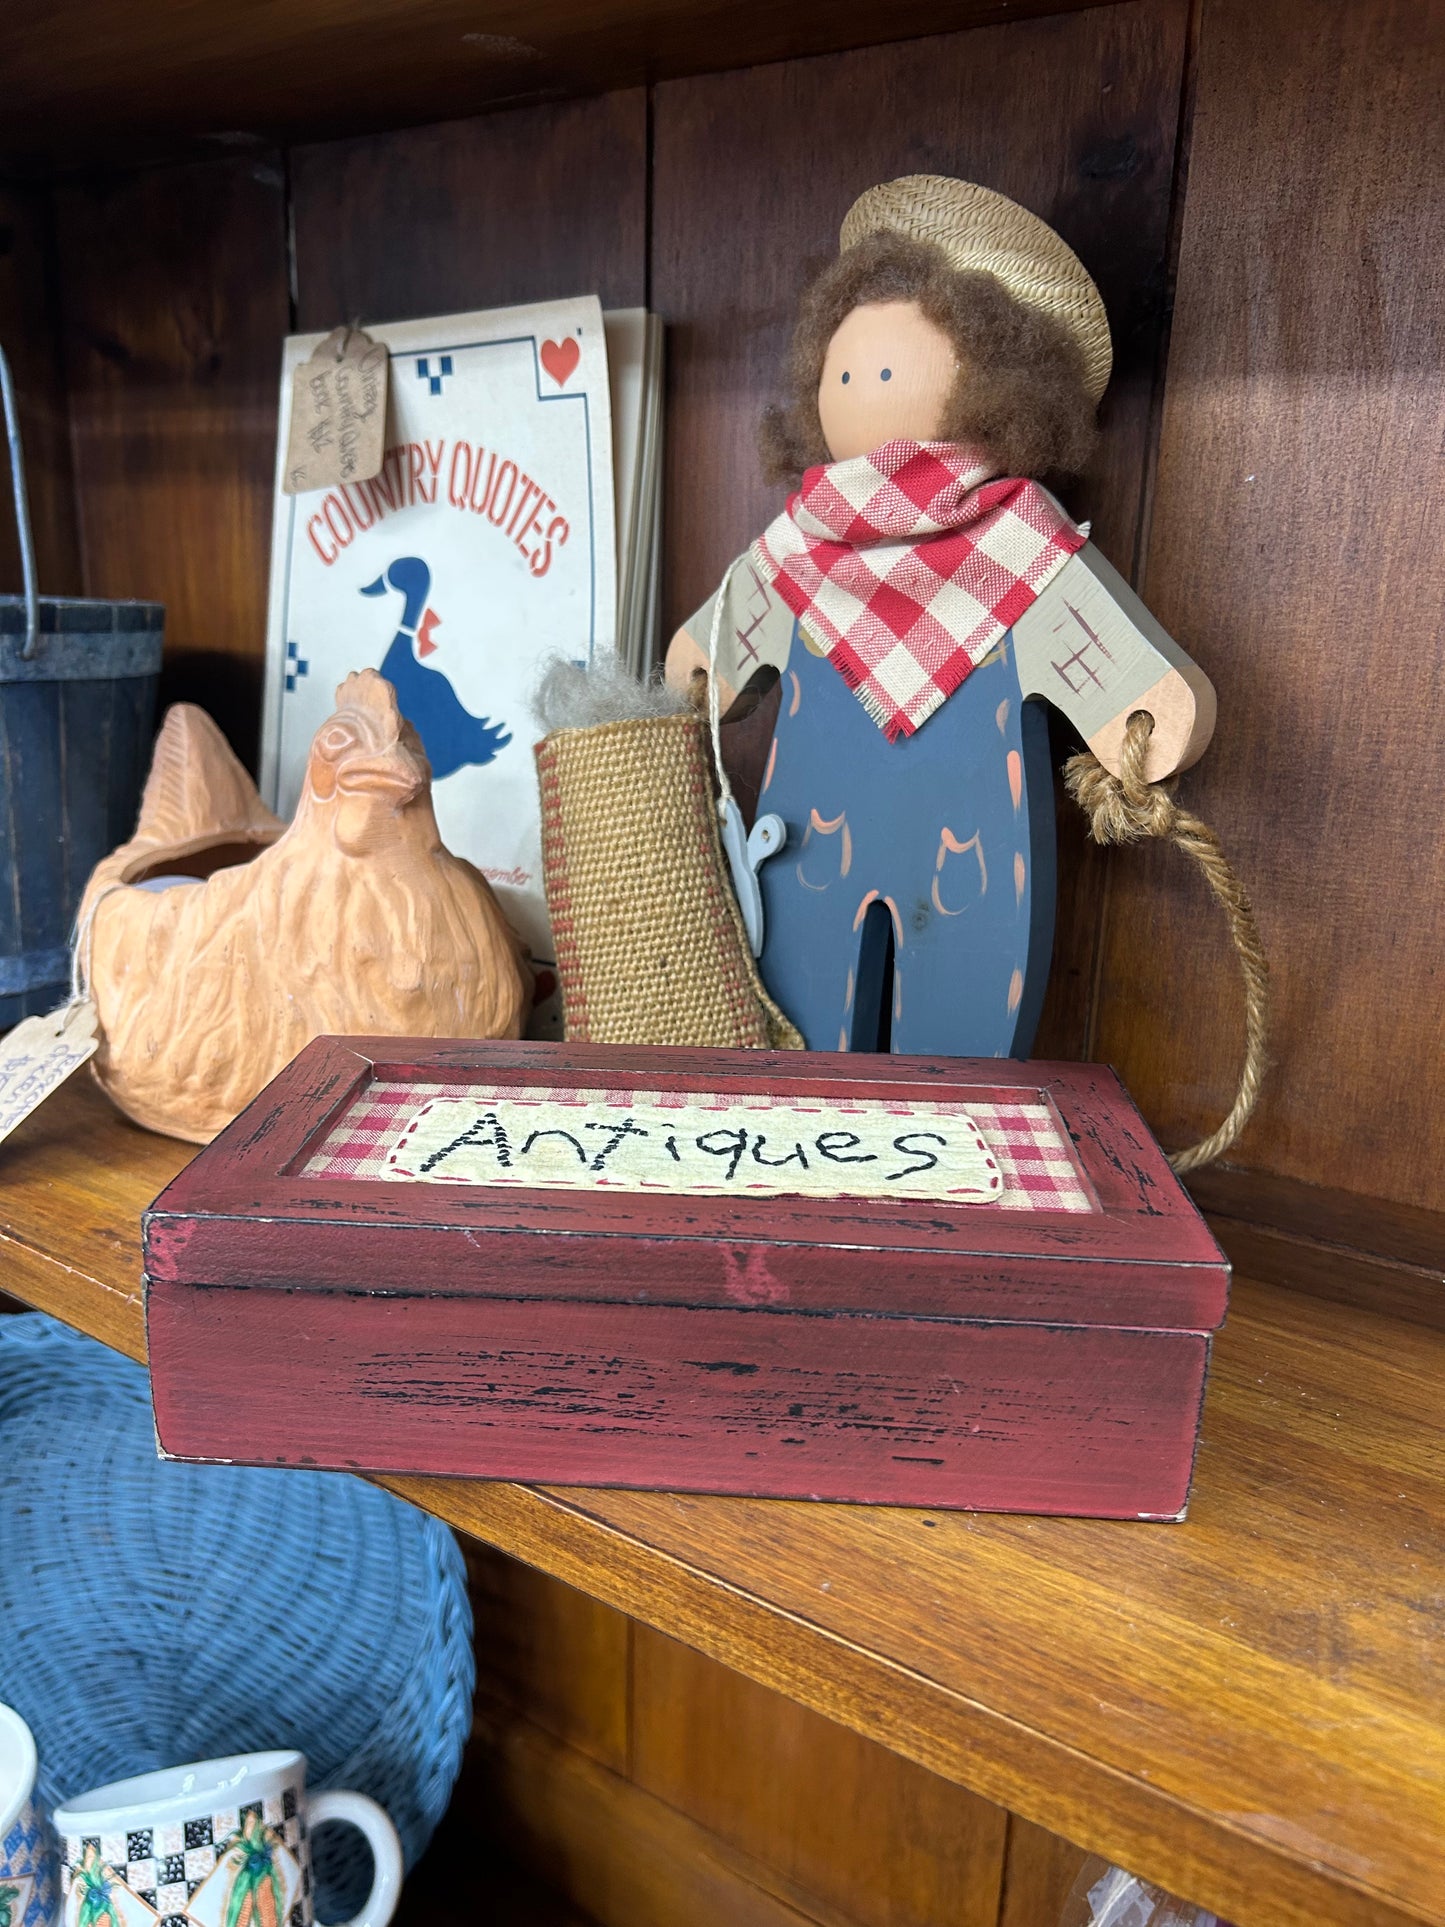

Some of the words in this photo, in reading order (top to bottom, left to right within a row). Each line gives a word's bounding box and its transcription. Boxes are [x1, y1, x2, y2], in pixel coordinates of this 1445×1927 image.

[306, 439, 445, 567] COUNTRY
[448, 439, 571, 578] QUOTES
[418, 1112, 948, 1181] Antiques
